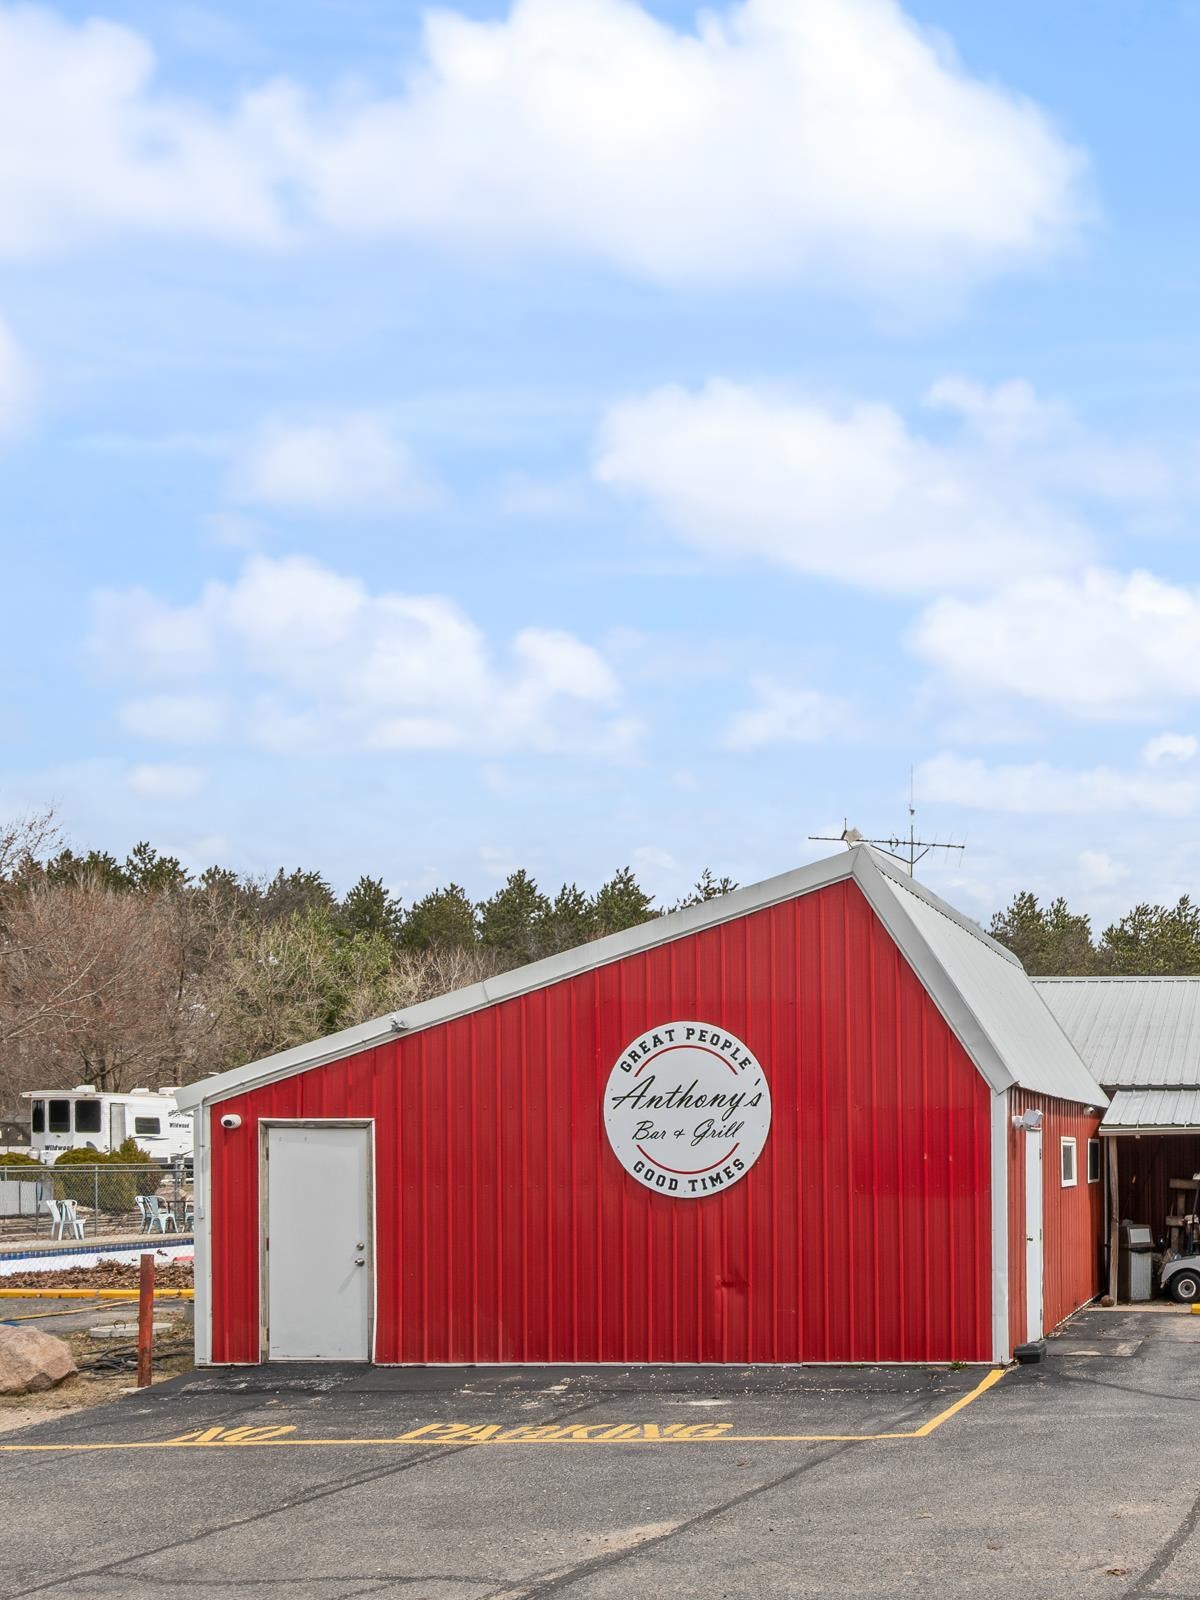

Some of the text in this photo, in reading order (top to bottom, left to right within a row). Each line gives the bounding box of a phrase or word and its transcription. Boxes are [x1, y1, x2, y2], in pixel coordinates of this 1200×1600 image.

[620, 1027, 752, 1073] GREAT PEOPLE
[611, 1075, 763, 1121] Anthony's
[631, 1120, 666, 1140] Bar
[690, 1119, 745, 1147] Grill
[633, 1158, 745, 1192] GOOD TIMES
[164, 1423, 734, 1442] NO PARKING
